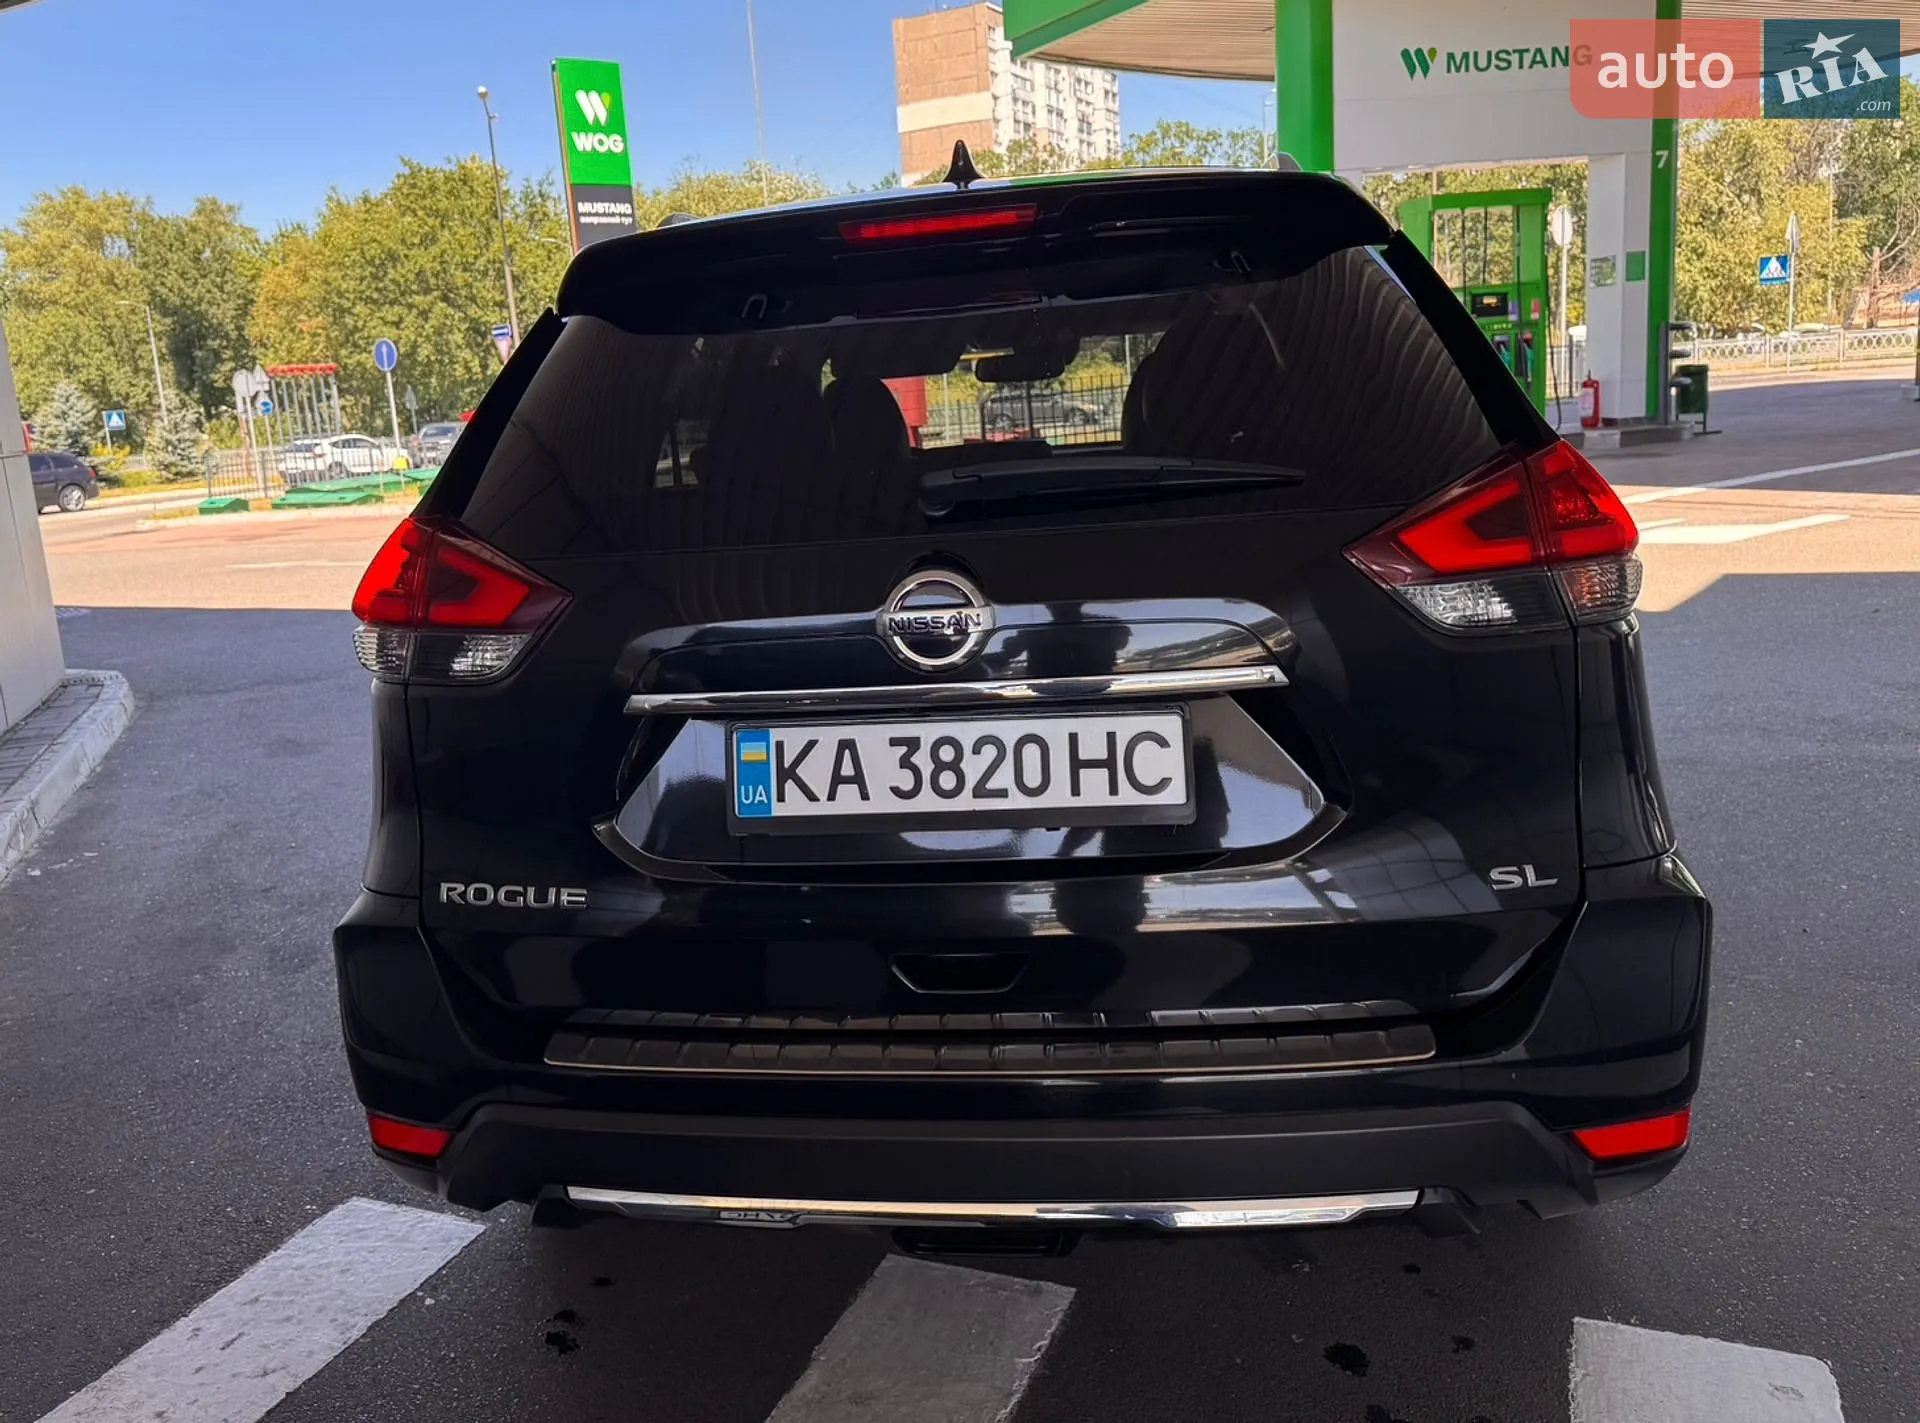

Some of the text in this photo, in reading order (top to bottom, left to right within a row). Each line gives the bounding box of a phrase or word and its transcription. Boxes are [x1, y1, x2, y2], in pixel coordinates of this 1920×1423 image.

[1446, 44, 1593, 75] MUSTANG
[571, 131, 624, 153] WOG
[1655, 150, 1669, 168] 7
[577, 201, 633, 215] MUSTANG
[888, 612, 982, 633] NISSAN
[774, 730, 1173, 803] KA 3820 HC
[740, 784, 768, 804] UA
[1488, 864, 1558, 891] SL
[439, 882, 588, 910] ROGUE
